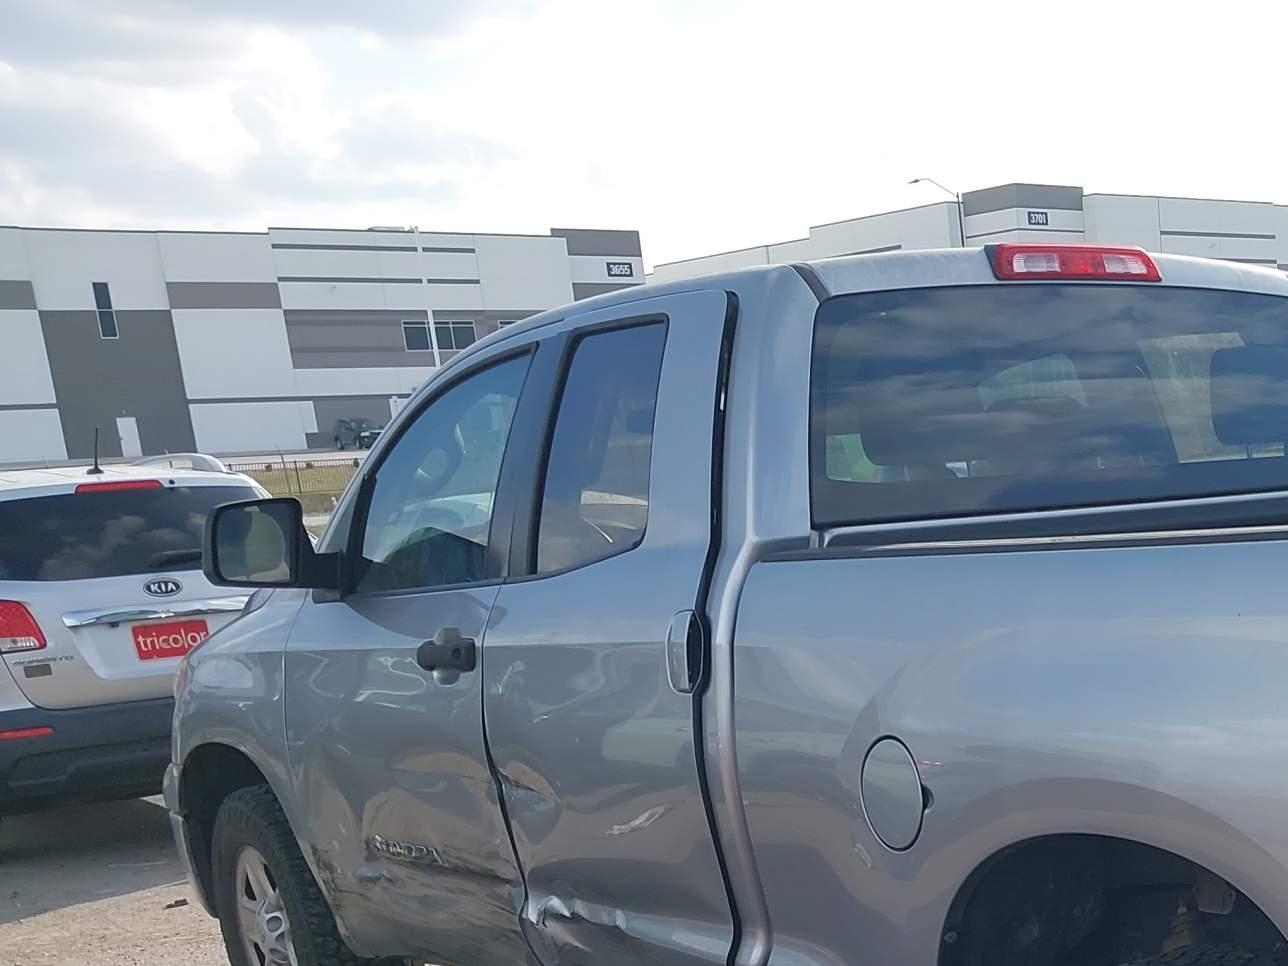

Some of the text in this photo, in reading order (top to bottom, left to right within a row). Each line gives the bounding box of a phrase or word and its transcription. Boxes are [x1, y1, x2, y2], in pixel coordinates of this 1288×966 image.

[1030, 213, 1046, 224] 3701
[609, 264, 631, 275] 3655
[150, 582, 177, 593] KIA
[137, 627, 207, 652] tricolor
